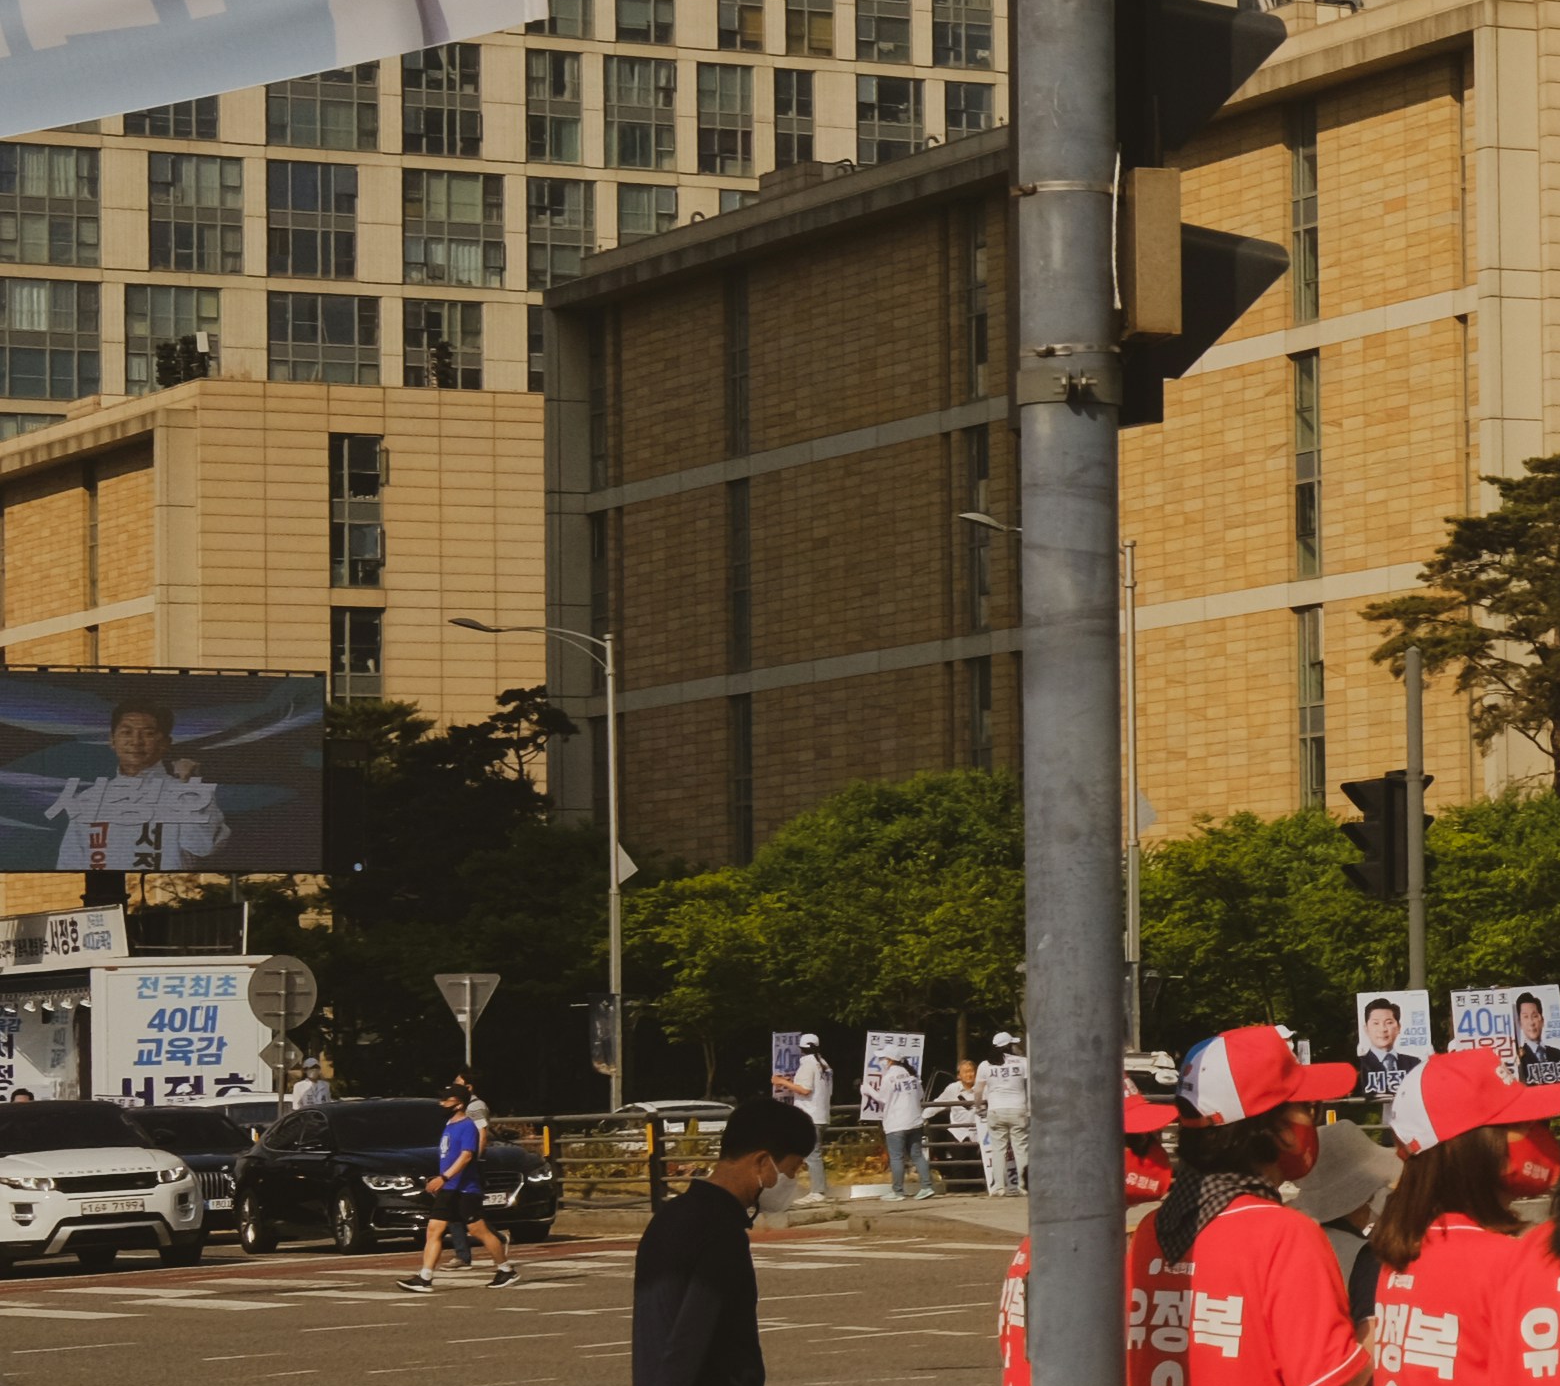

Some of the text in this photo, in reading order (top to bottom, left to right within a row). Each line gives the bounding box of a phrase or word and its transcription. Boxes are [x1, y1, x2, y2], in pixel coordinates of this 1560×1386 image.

[137, 975, 238, 1000] 전국최초
[1455, 995, 1509, 1009] 전국최초
[146, 1005, 219, 1034] 40대
[1457, 1007, 1513, 1038] 40대
[133, 1035, 229, 1067] 교육감
